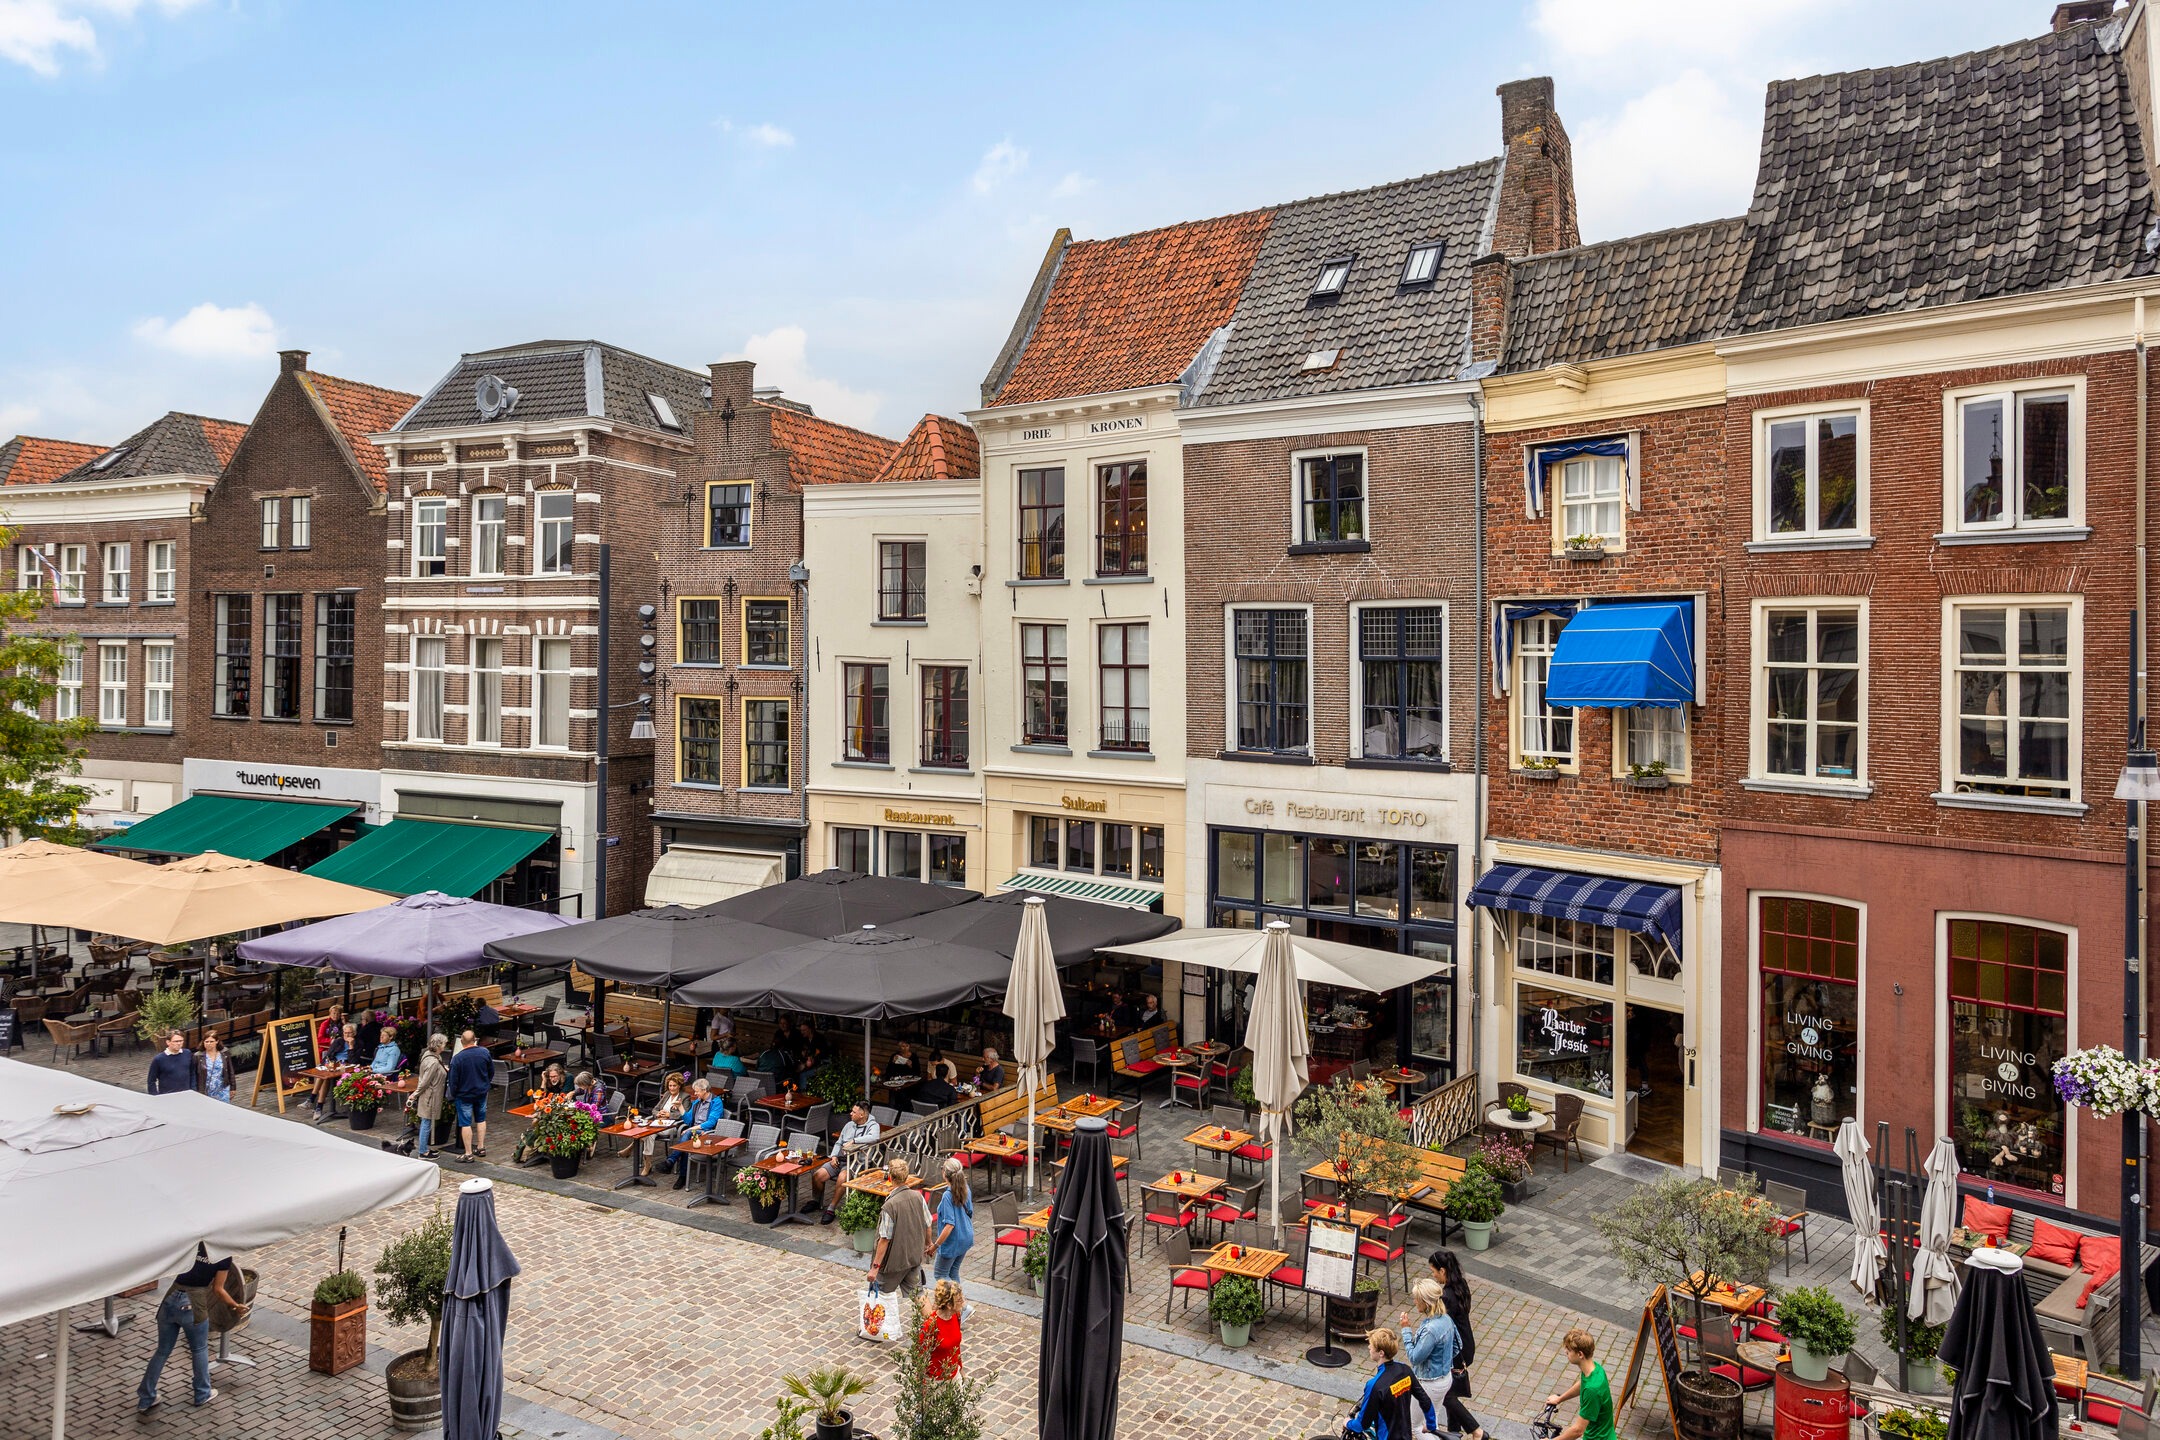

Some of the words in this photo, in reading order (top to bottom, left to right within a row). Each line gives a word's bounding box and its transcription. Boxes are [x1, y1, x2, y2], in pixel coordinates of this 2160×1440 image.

[1023, 428, 1052, 440] DRIE
[1091, 417, 1143, 433] KRONEN
[1061, 795, 1106, 813] Sultani
[1244, 798, 1275, 816] Café
[1286, 801, 1366, 823] Restaurant
[1378, 808, 1427, 827] TORO
[884, 807, 955, 826] Restaurant
[281, 1021, 306, 1032] Sultani
[1540, 1007, 1587, 1036] Barber
[1787, 1011, 1833, 1031] LIVING
[1549, 1030, 1589, 1056] Jessie
[1685, 1048, 1696, 1058] 39
[1786, 1042, 1833, 1061] GIVING
[1981, 1045, 2036, 1066] LIVING
[1981, 1078, 2036, 1099] GIVING
